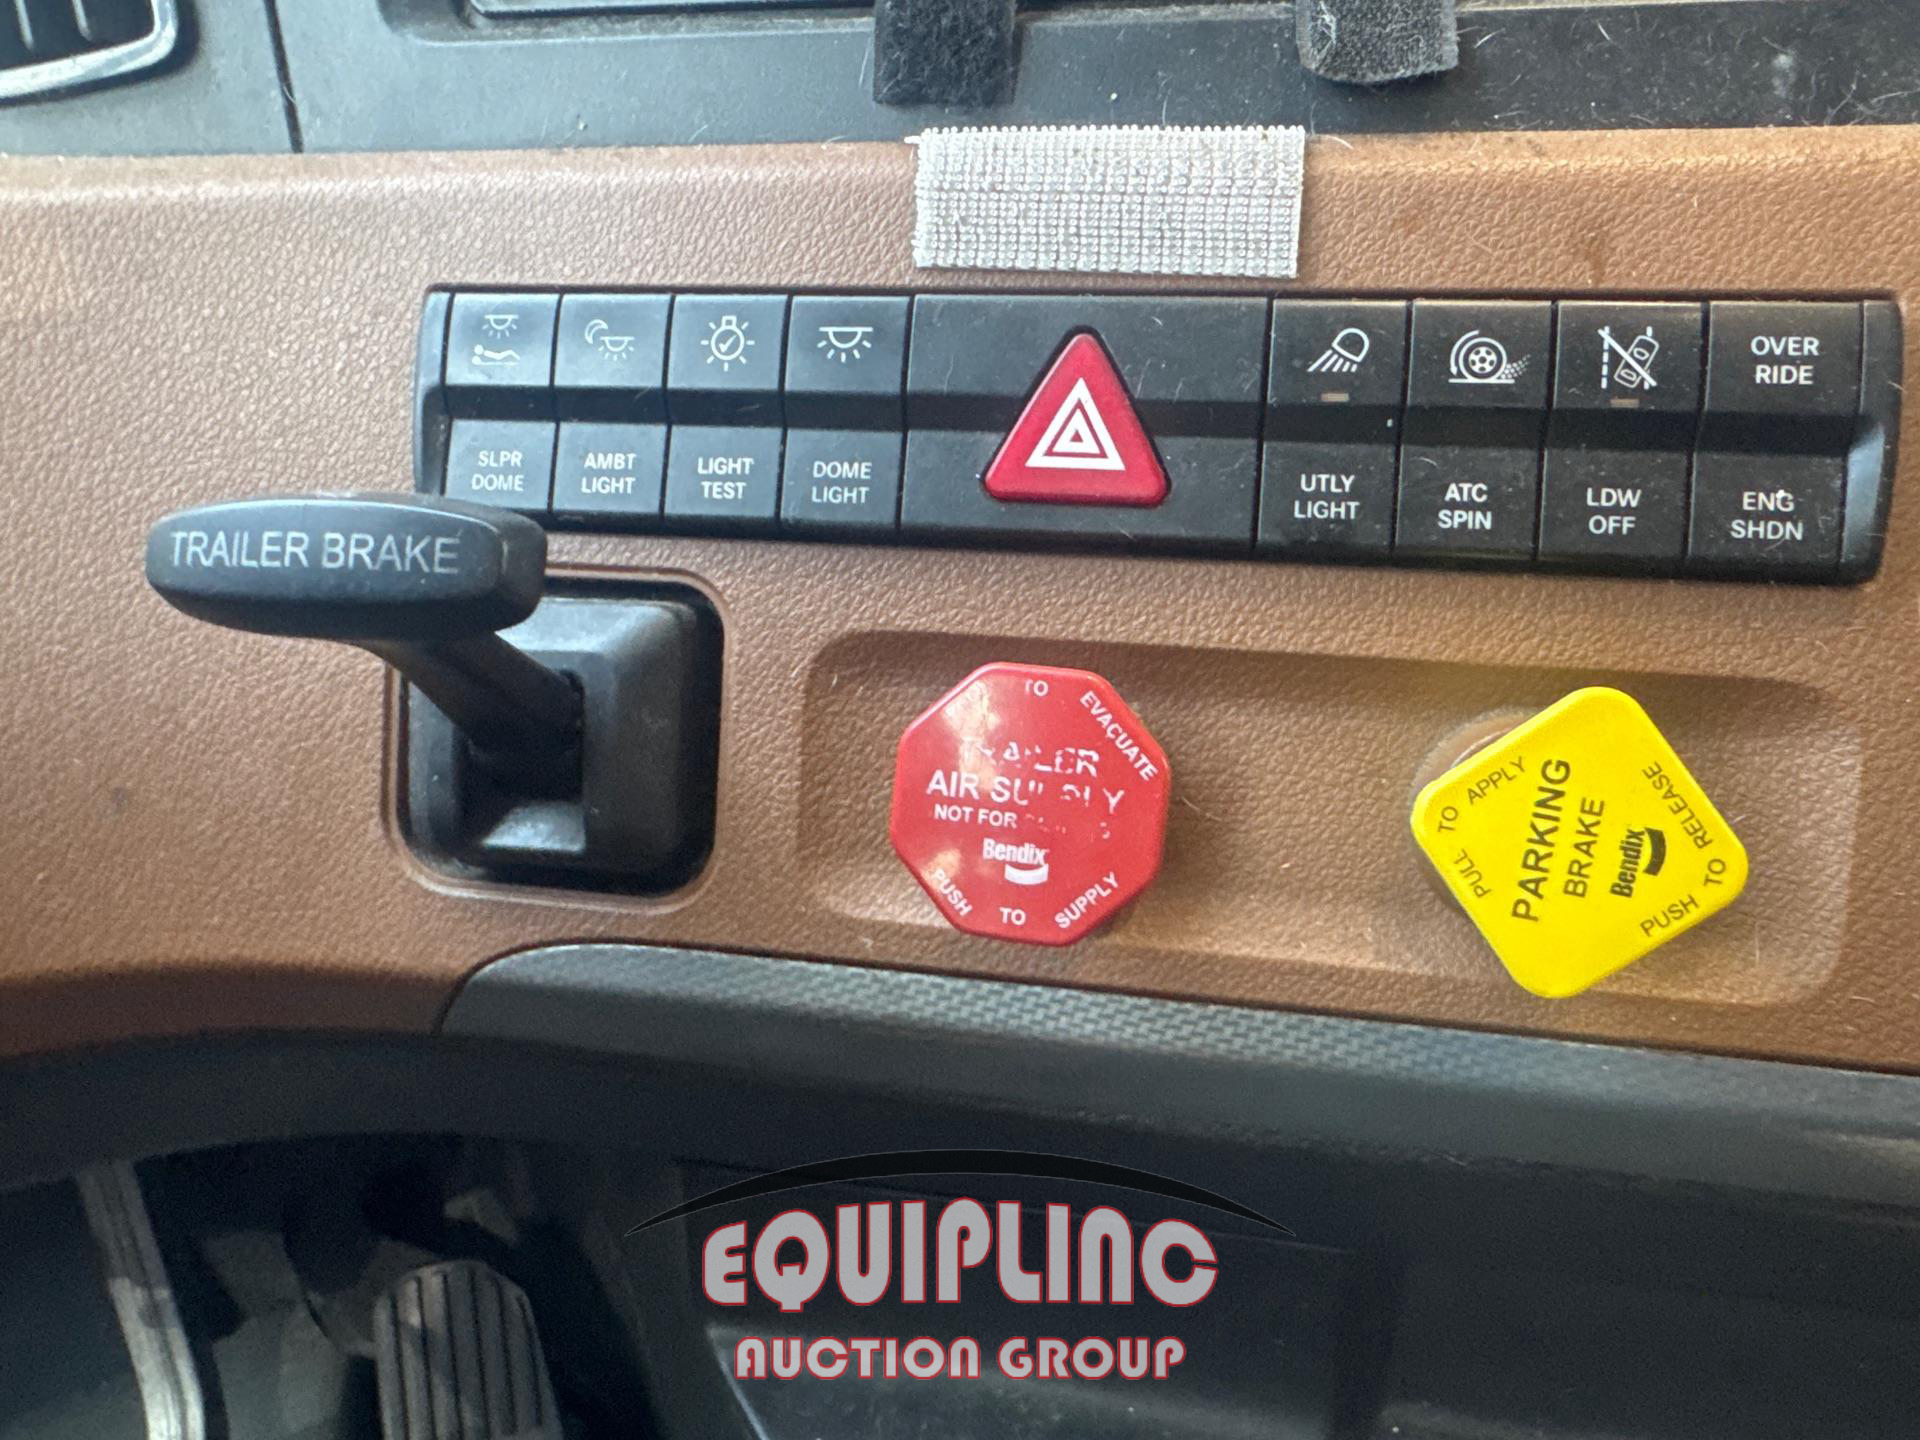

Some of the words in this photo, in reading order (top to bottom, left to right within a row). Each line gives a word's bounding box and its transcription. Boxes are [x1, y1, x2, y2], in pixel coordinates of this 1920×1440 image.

[1749, 335, 1820, 358] OVER
[1754, 364, 1814, 387] RIDE
[478, 450, 523, 469] SLPR
[584, 452, 637, 471] AMBT
[697, 457, 755, 475] LIGHT
[812, 461, 872, 480] DOME
[471, 473, 524, 492] DOME
[581, 476, 636, 496] LIGHT
[701, 481, 746, 500] TEST
[1300, 473, 1355, 494] UTLY
[1444, 482, 1488, 503] ATC
[811, 486, 870, 505] LIGHT
[1586, 487, 1642, 508] LDW
[1742, 490, 1795, 514] ENG
[1293, 500, 1360, 522] LIGHT
[1438, 509, 1493, 532] SPIN
[1588, 514, 1636, 536] OFF
[1730, 519, 1804, 541] SHDN
[170, 531, 310, 568] TRAILER
[321, 532, 462, 574] BRAKE
[1080, 690, 1159, 781] EVACUATE
[926, 770, 979, 800] AIR
[1466, 755, 1527, 806] APPLY
[934, 803, 974, 824] NOT
[977, 808, 1018, 829] FOR
[1642, 760, 1713, 849] RELEASE
[1438, 805, 1459, 834] TO
[982, 837, 1049, 866] Bendix
[1511, 759, 1571, 923] PARKING
[1563, 797, 1605, 898] BRAKE
[1453, 849, 1492, 898] PULL
[1609, 827, 1646, 898] Bendix
[1704, 857, 1726, 888] TO
[932, 868, 973, 917] PUSH
[999, 907, 1026, 926] TO
[1054, 871, 1119, 928] SUPPLY
[1639, 894, 1700, 938] PUSH
